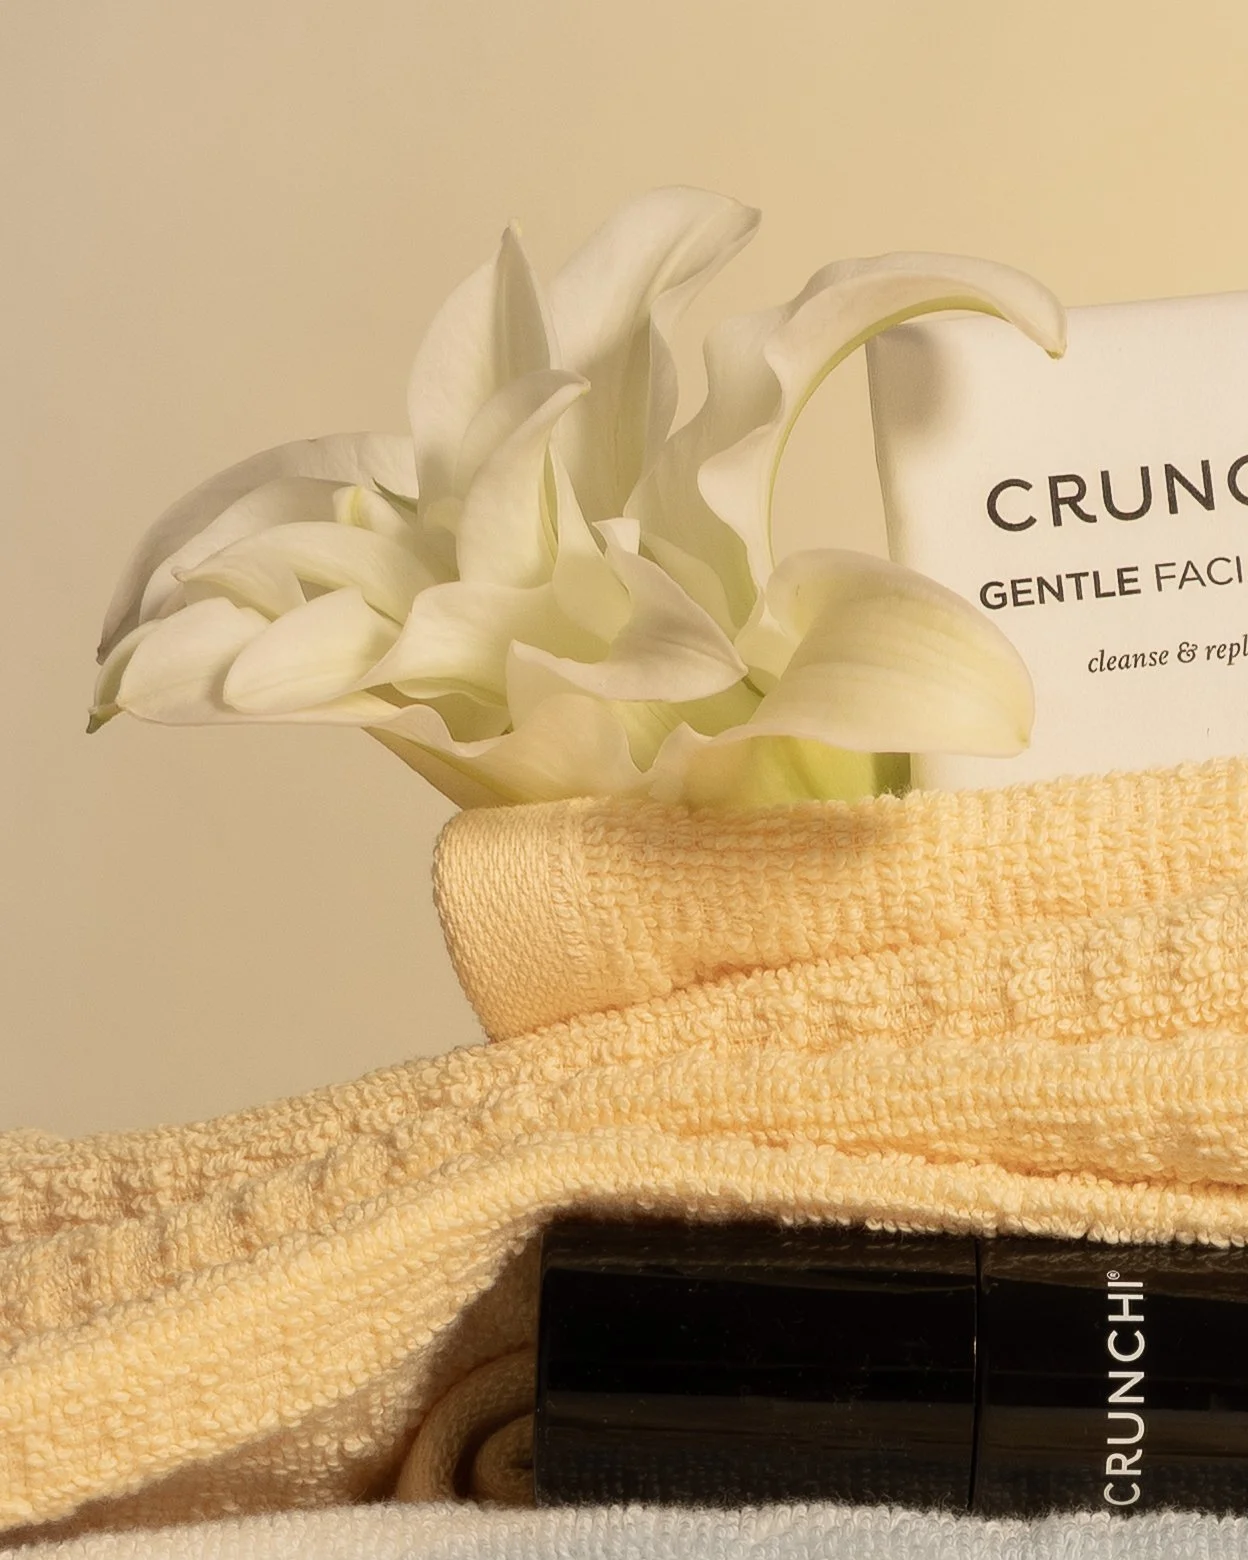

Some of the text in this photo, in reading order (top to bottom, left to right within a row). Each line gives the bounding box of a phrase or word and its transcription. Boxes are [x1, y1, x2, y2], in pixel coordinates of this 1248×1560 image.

[979, 565, 1141, 609] GENTLE
[1087, 645, 1168, 672] cleanse
[1176, 642, 1198, 663] &
